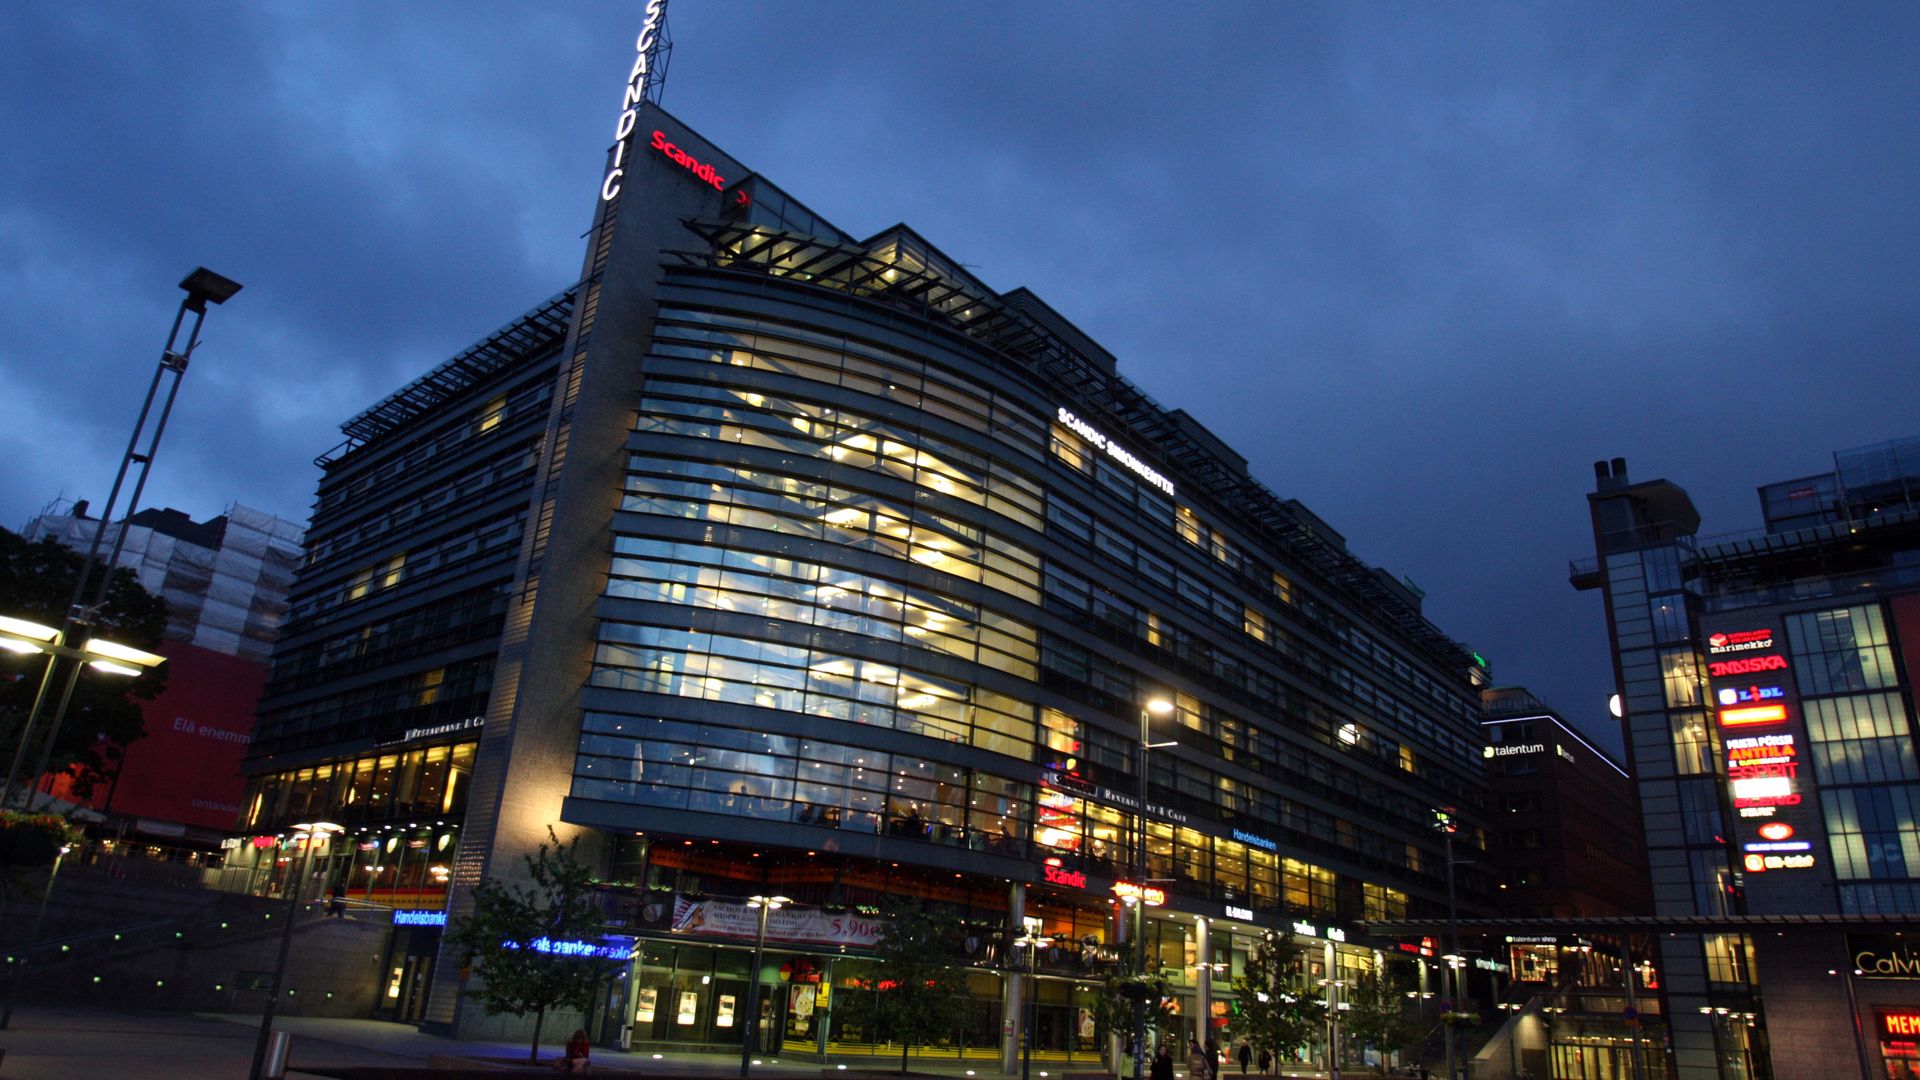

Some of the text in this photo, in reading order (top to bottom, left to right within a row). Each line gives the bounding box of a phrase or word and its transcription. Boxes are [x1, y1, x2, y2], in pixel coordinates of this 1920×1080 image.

[602, 0, 660, 200] SCANDIC
[650, 130, 725, 191] Scandic
[1058, 408, 1106, 449] SCANDIC
[1495, 744, 1544, 757] talentum
[1728, 762, 1799, 782] ESPRIT
[1105, 789, 1157, 812] RESTAUNT
[1233, 828, 1277, 851] Handelsbanken
[1044, 866, 1087, 889] Scandic
